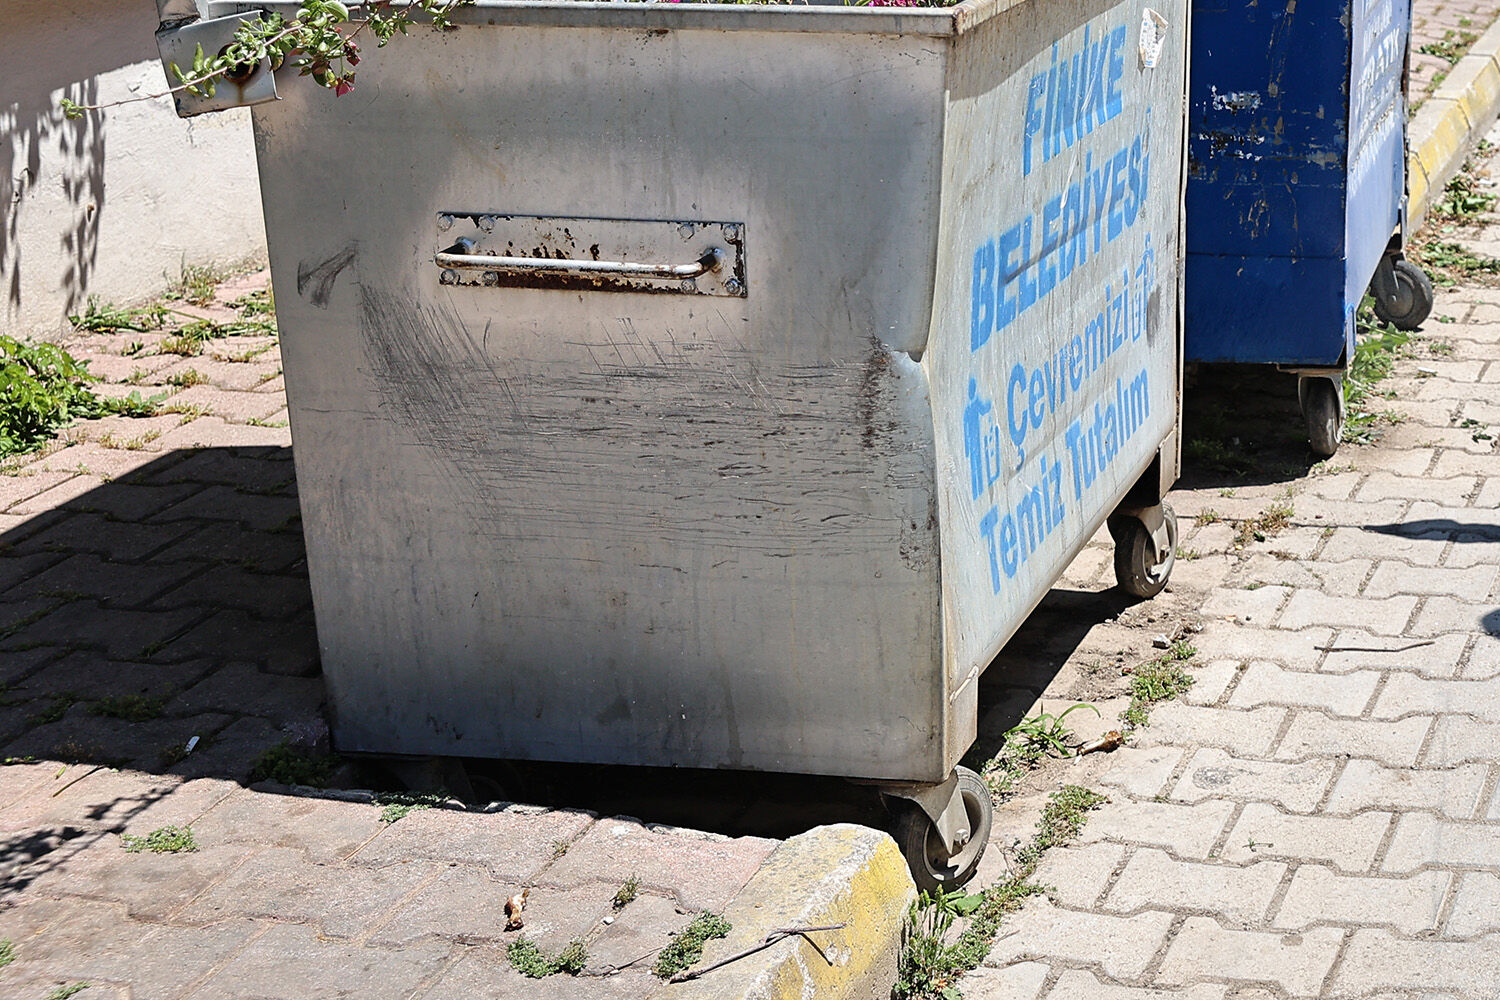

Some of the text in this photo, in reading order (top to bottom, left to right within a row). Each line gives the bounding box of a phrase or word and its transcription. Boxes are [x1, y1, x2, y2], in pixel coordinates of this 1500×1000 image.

[1023, 24, 1127, 177] FİNİKE
[971, 107, 1151, 353] BELEDİYESİ
[1007, 268, 1129, 473] Çevremizi
[979, 367, 1150, 596] Temiz Tutalım
